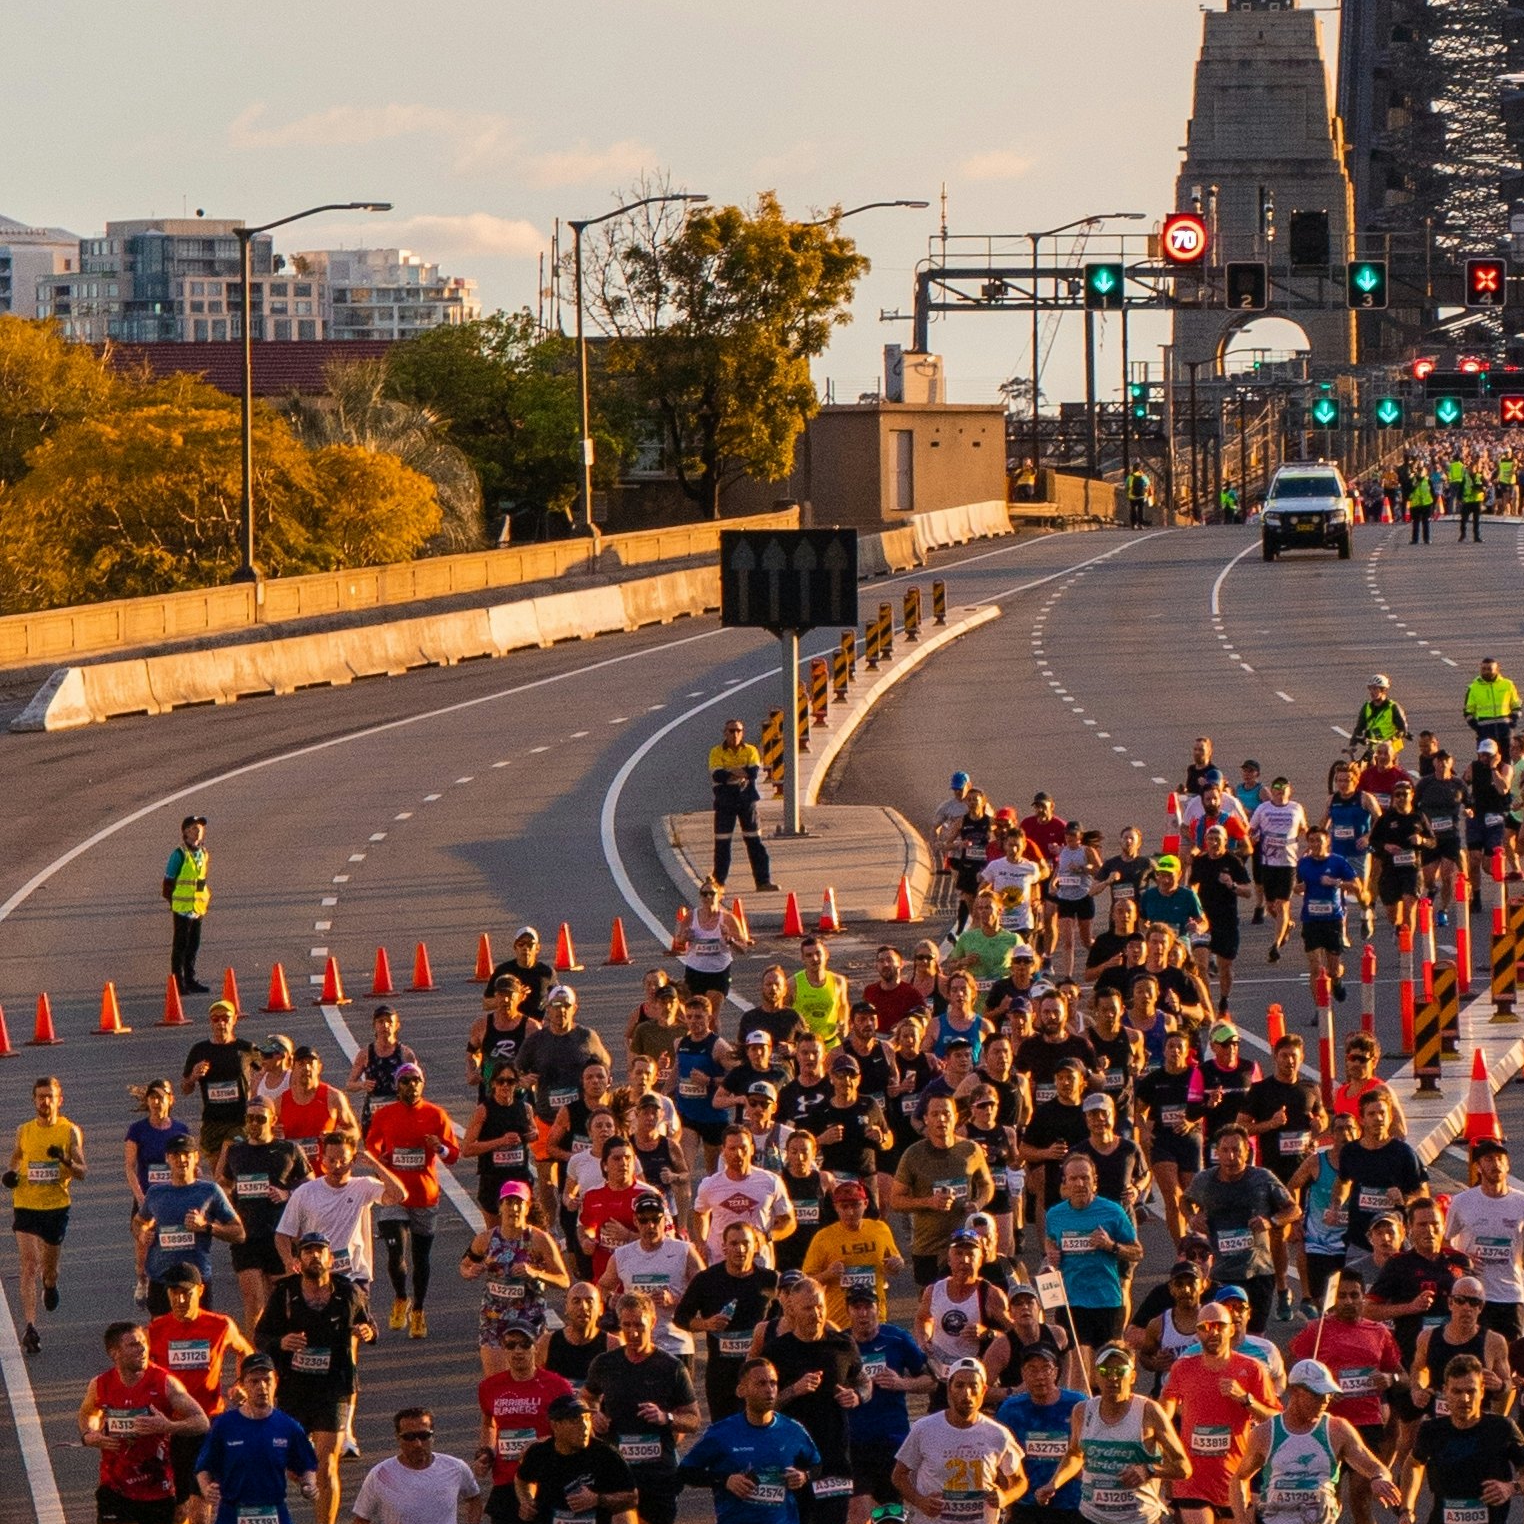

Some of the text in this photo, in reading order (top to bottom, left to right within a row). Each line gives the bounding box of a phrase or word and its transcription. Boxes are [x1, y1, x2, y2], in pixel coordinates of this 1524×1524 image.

[1172, 230, 1197, 250] 70
[1102, 295, 1107, 309] 1
[1240, 294, 1252, 308] 2
[1362, 292, 1373, 307] 3
[1479, 292, 1493, 306] 4
[841, 1241, 876, 1255] LSU
[722, 1340, 751, 1350] A3316
[620, 1446, 660, 1456] A33050
[1028, 1442, 1067, 1453] A32753
[944, 1458, 984, 1491] 21
[752, 1486, 784, 1498] 32574
[1447, 1510, 1486, 1522] A31803
